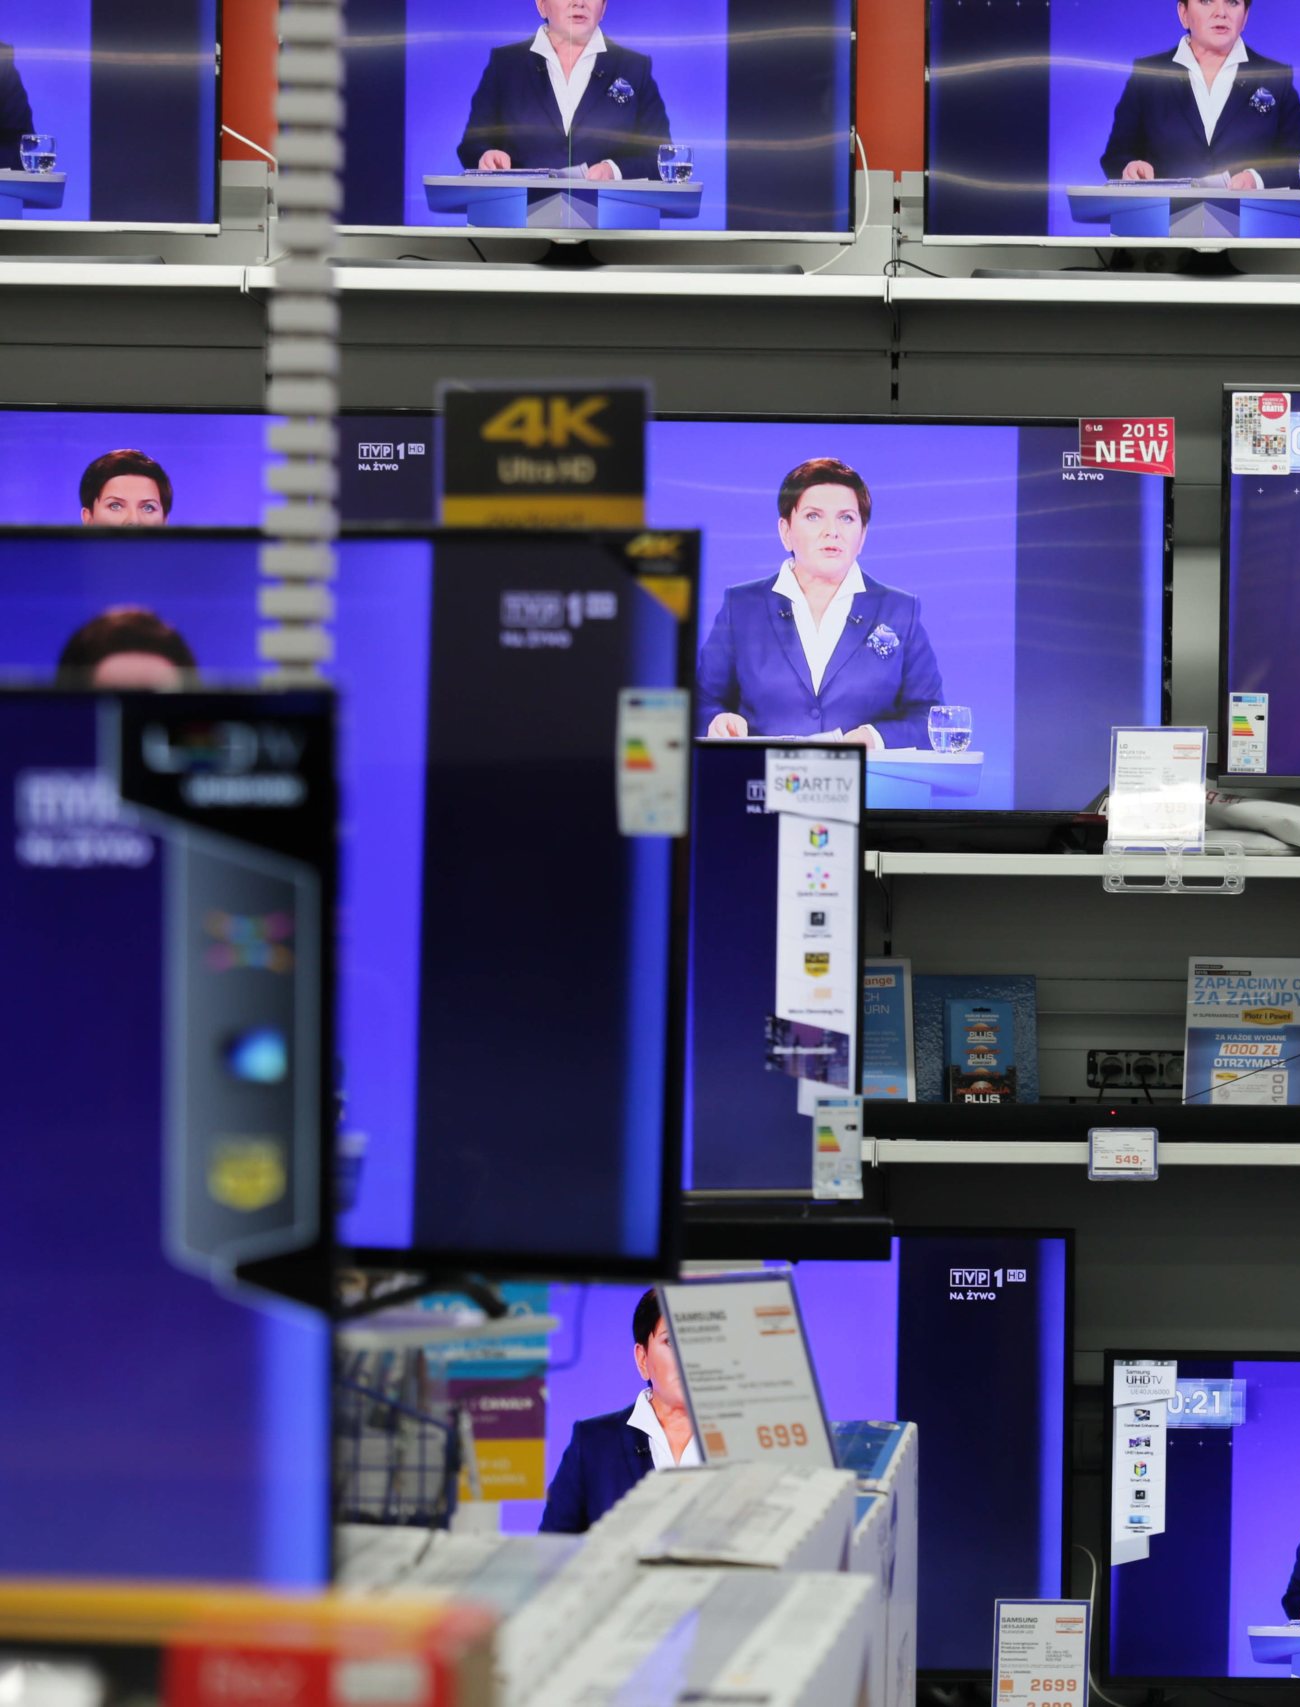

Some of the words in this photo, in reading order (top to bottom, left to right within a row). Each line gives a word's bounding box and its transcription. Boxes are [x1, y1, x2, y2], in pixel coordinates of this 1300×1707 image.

[481, 397, 612, 447] 4K
[1122, 424, 1168, 437] 2015
[360, 443, 392, 458] TVP
[397, 443, 405, 459] 1
[408, 443, 425, 454] HD
[1095, 440, 1168, 462] NEW
[358, 463, 371, 471] NA
[373, 461, 399, 471] ŻYWO
[1063, 472, 1075, 480] NA
[1077, 471, 1104, 480] ŻYWO
[835, 778, 853, 792] TV
[864, 976, 893, 986] ange
[1194, 977, 1288, 990] ZAPŁACIMY
[1194, 991, 1220, 1005] ZA
[1222, 1044, 1259, 1055] 1000
[1263, 1044, 1280, 1055] ZŁ
[1214, 1058, 1287, 1069] OTRZYMASZ
[965, 1094, 1001, 1104] PLUS
[951, 1269, 989, 1286] TVP
[994, 1268, 1003, 1287] 1
[1007, 1269, 1026, 1282] HD
[950, 1292, 964, 1300] NA
[966, 1290, 996, 1300] ŻYWO
[1126, 1375, 1150, 1384] UHD
[1151, 1375, 1163, 1384] TV
[1167, 1391, 1221, 1414] 0:21
[757, 1423, 808, 1449] 699
[1030, 1679, 1077, 1692] 2699
